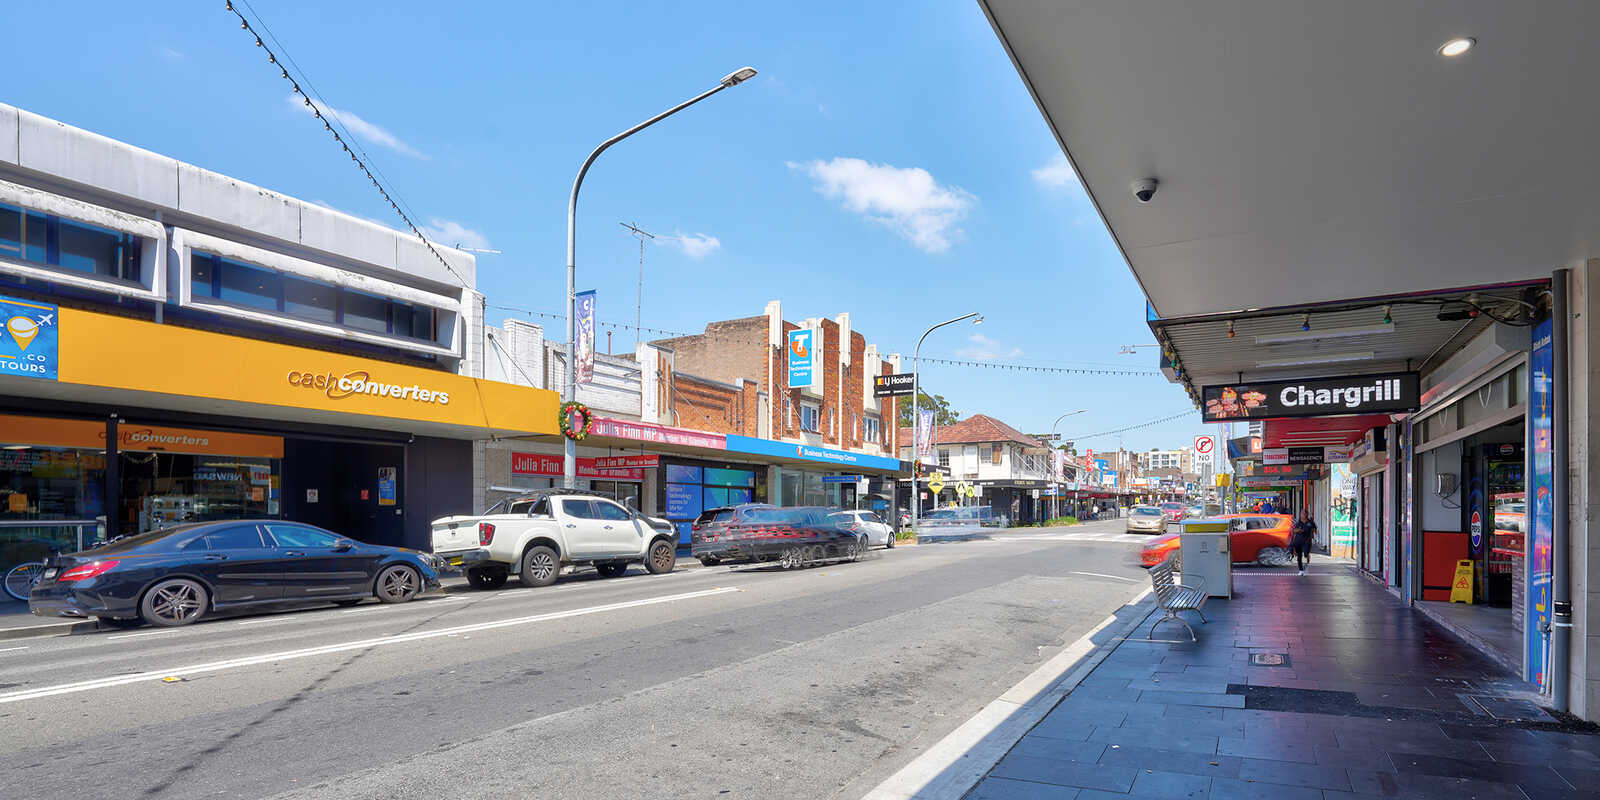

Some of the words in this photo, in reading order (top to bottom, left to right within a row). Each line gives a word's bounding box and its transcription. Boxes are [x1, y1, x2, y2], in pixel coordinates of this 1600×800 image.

[22, 353, 46, 362] .CO
[891, 376, 914, 384] Hooker
[1280, 379, 1401, 408] Chargrill
[596, 421, 619, 436] Julia
[623, 424, 641, 438] Finn
[643, 427, 657, 440] MP
[515, 456, 538, 472] Julia
[541, 458, 559, 472] Finn
